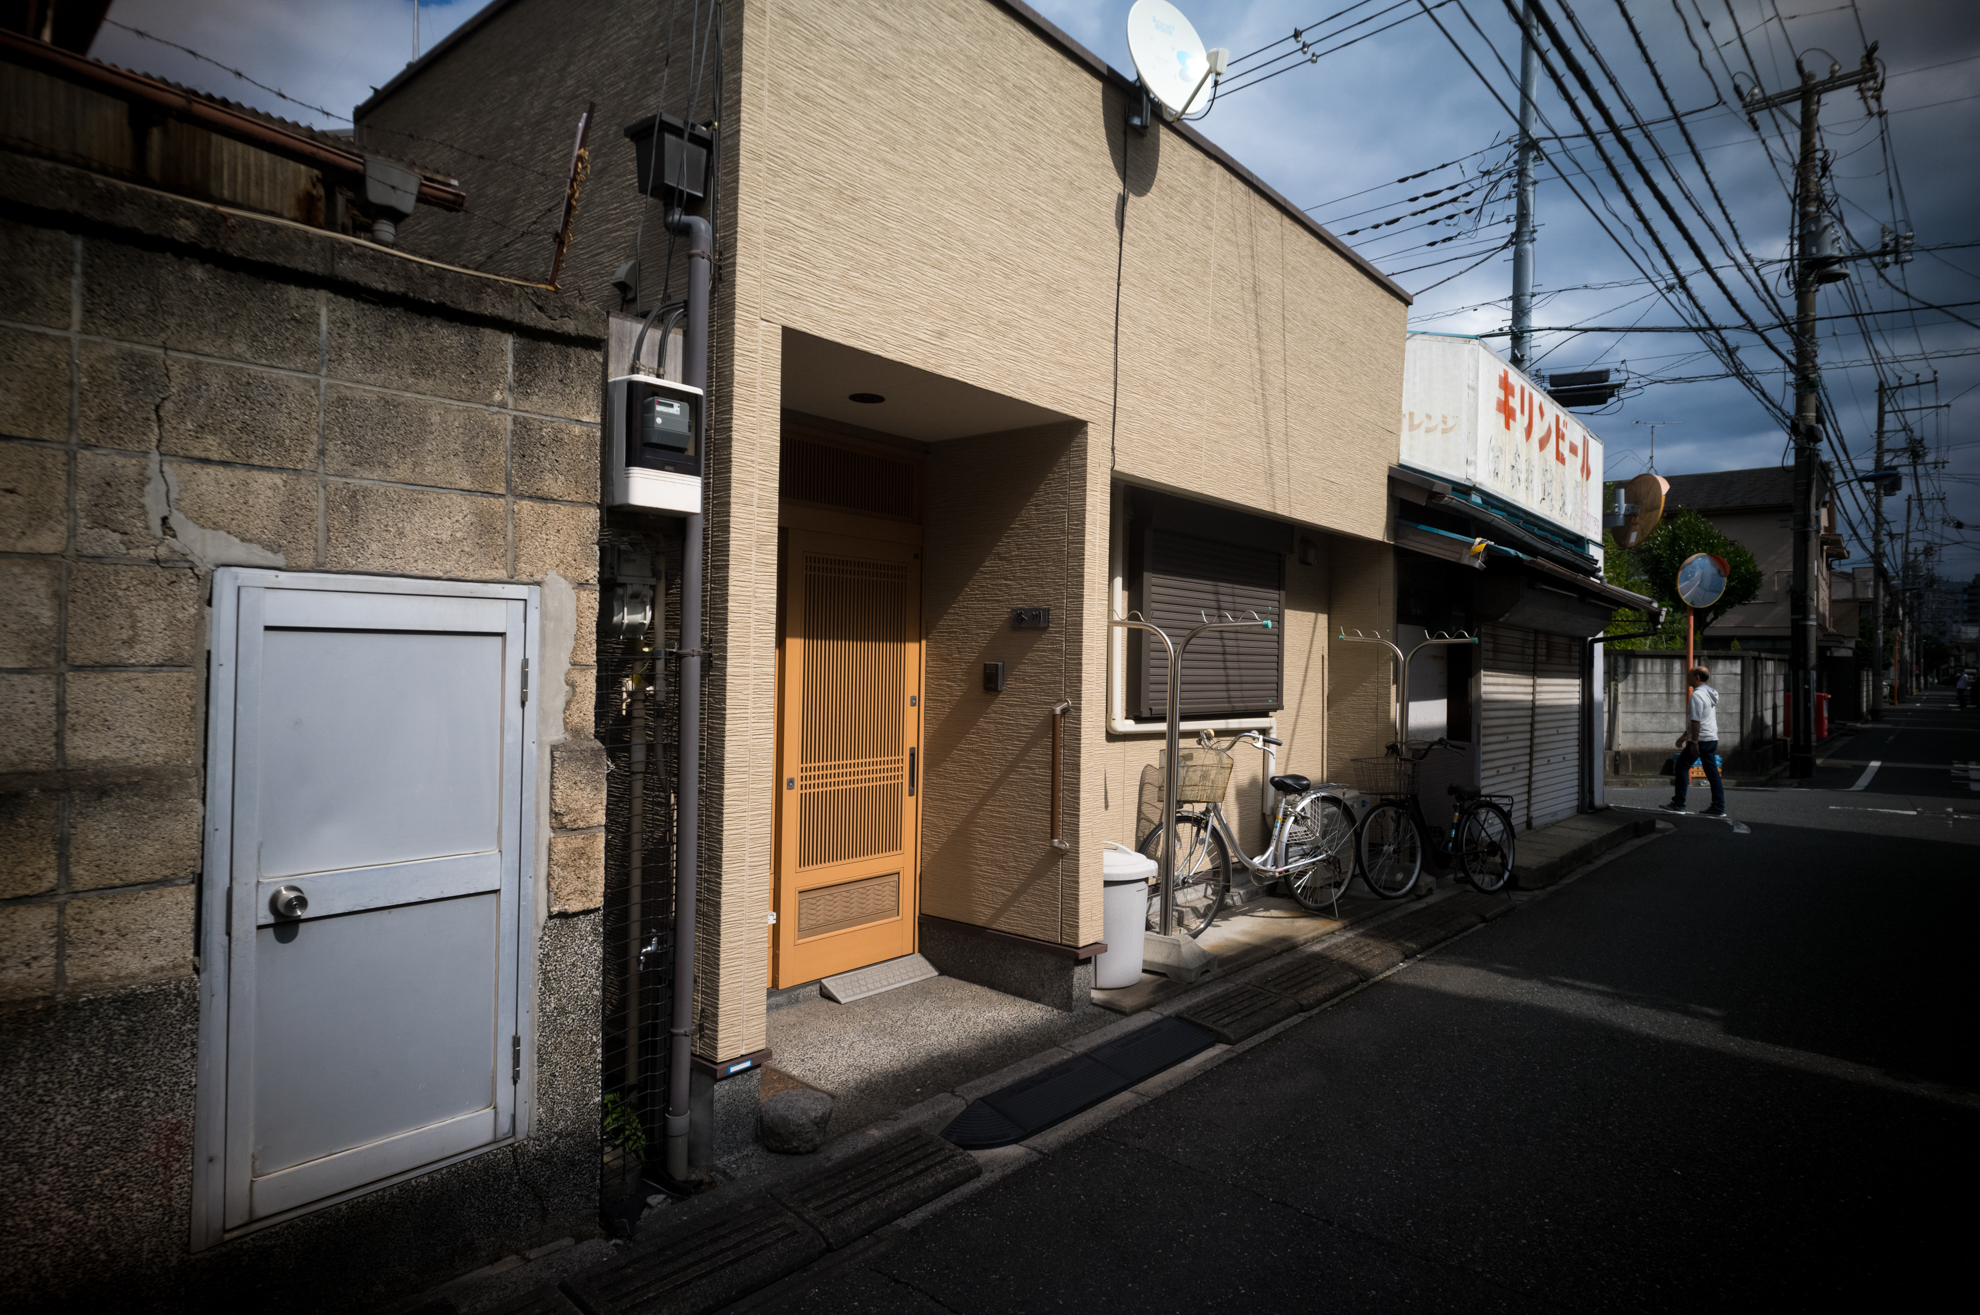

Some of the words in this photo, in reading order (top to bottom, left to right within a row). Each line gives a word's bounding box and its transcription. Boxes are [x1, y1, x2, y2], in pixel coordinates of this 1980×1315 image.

[1401, 411, 1459, 435] レンジ
[1495, 368, 1592, 482] キリンビール
